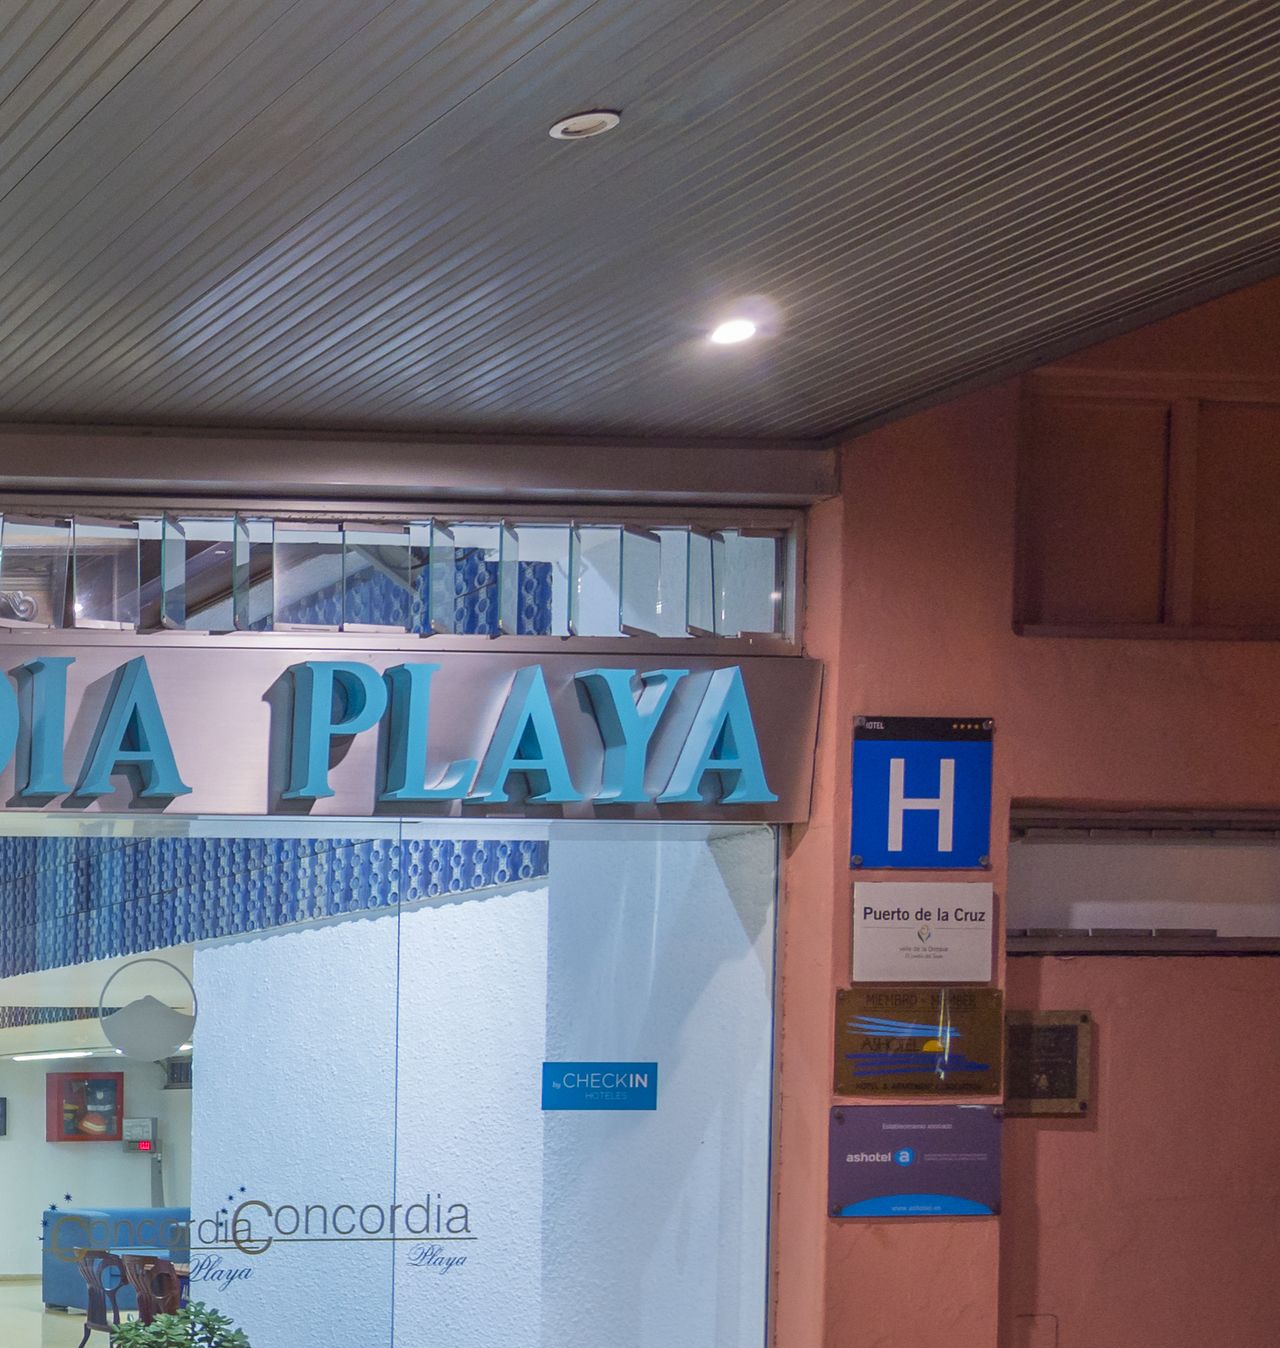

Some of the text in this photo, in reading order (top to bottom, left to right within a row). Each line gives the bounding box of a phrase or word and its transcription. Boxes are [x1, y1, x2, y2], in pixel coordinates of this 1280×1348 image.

[280, 660, 778, 805] PLAYA
[865, 721, 884, 730] OTEL
[887, 758, 955, 852] H
[863, 906, 986, 922] Puerto de la Cruz
[563, 1073, 648, 1088] CHECKIN
[846, 1152, 891, 1163] ashotel
[51, 1211, 252, 1264] Concordia
[232, 1193, 471, 1255] Concordia
[186, 1253, 254, 1292] Playa
[407, 1243, 468, 1275] Playa
